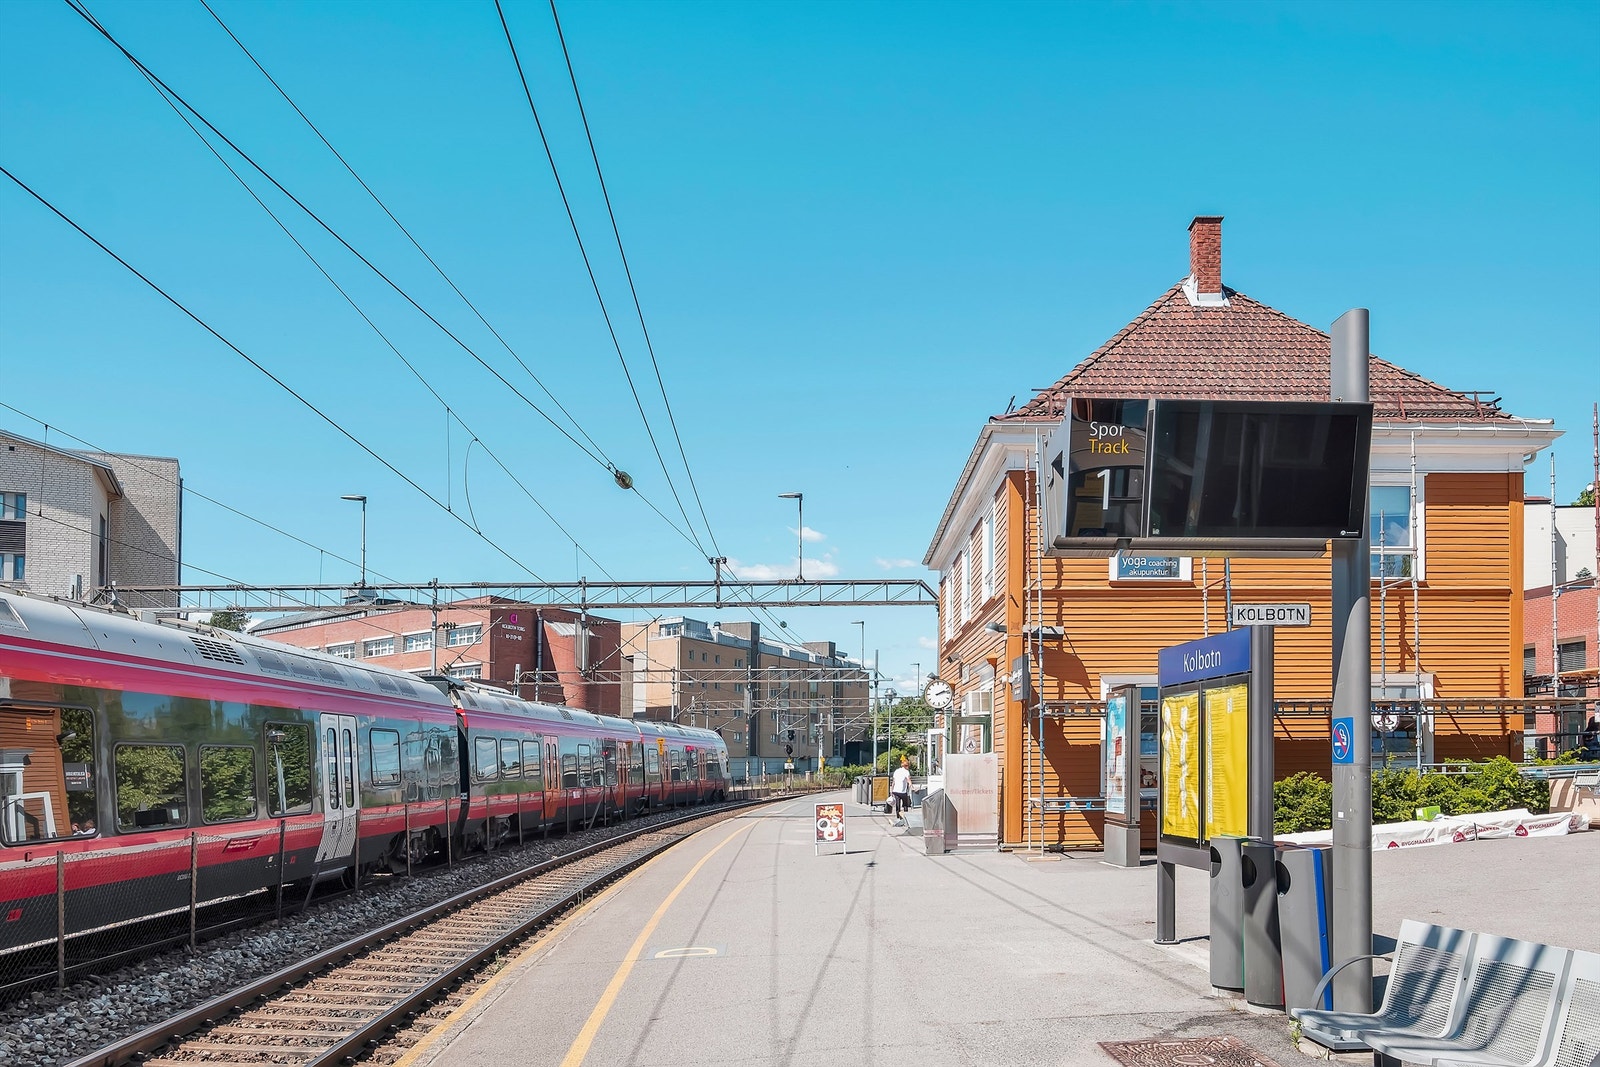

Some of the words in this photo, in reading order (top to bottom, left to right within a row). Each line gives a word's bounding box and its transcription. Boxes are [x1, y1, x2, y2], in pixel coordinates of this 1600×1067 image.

[1089, 421, 1125, 440] Spor
[1088, 439, 1129, 454] Track
[1097, 468, 1111, 510] 1
[1121, 556, 1147, 568] yoga
[1148, 558, 1178, 569] coaching
[1128, 567, 1169, 577] akupunktur
[1237, 608, 1306, 621] KOLBOTN
[1183, 649, 1221, 673] Kolbotn
